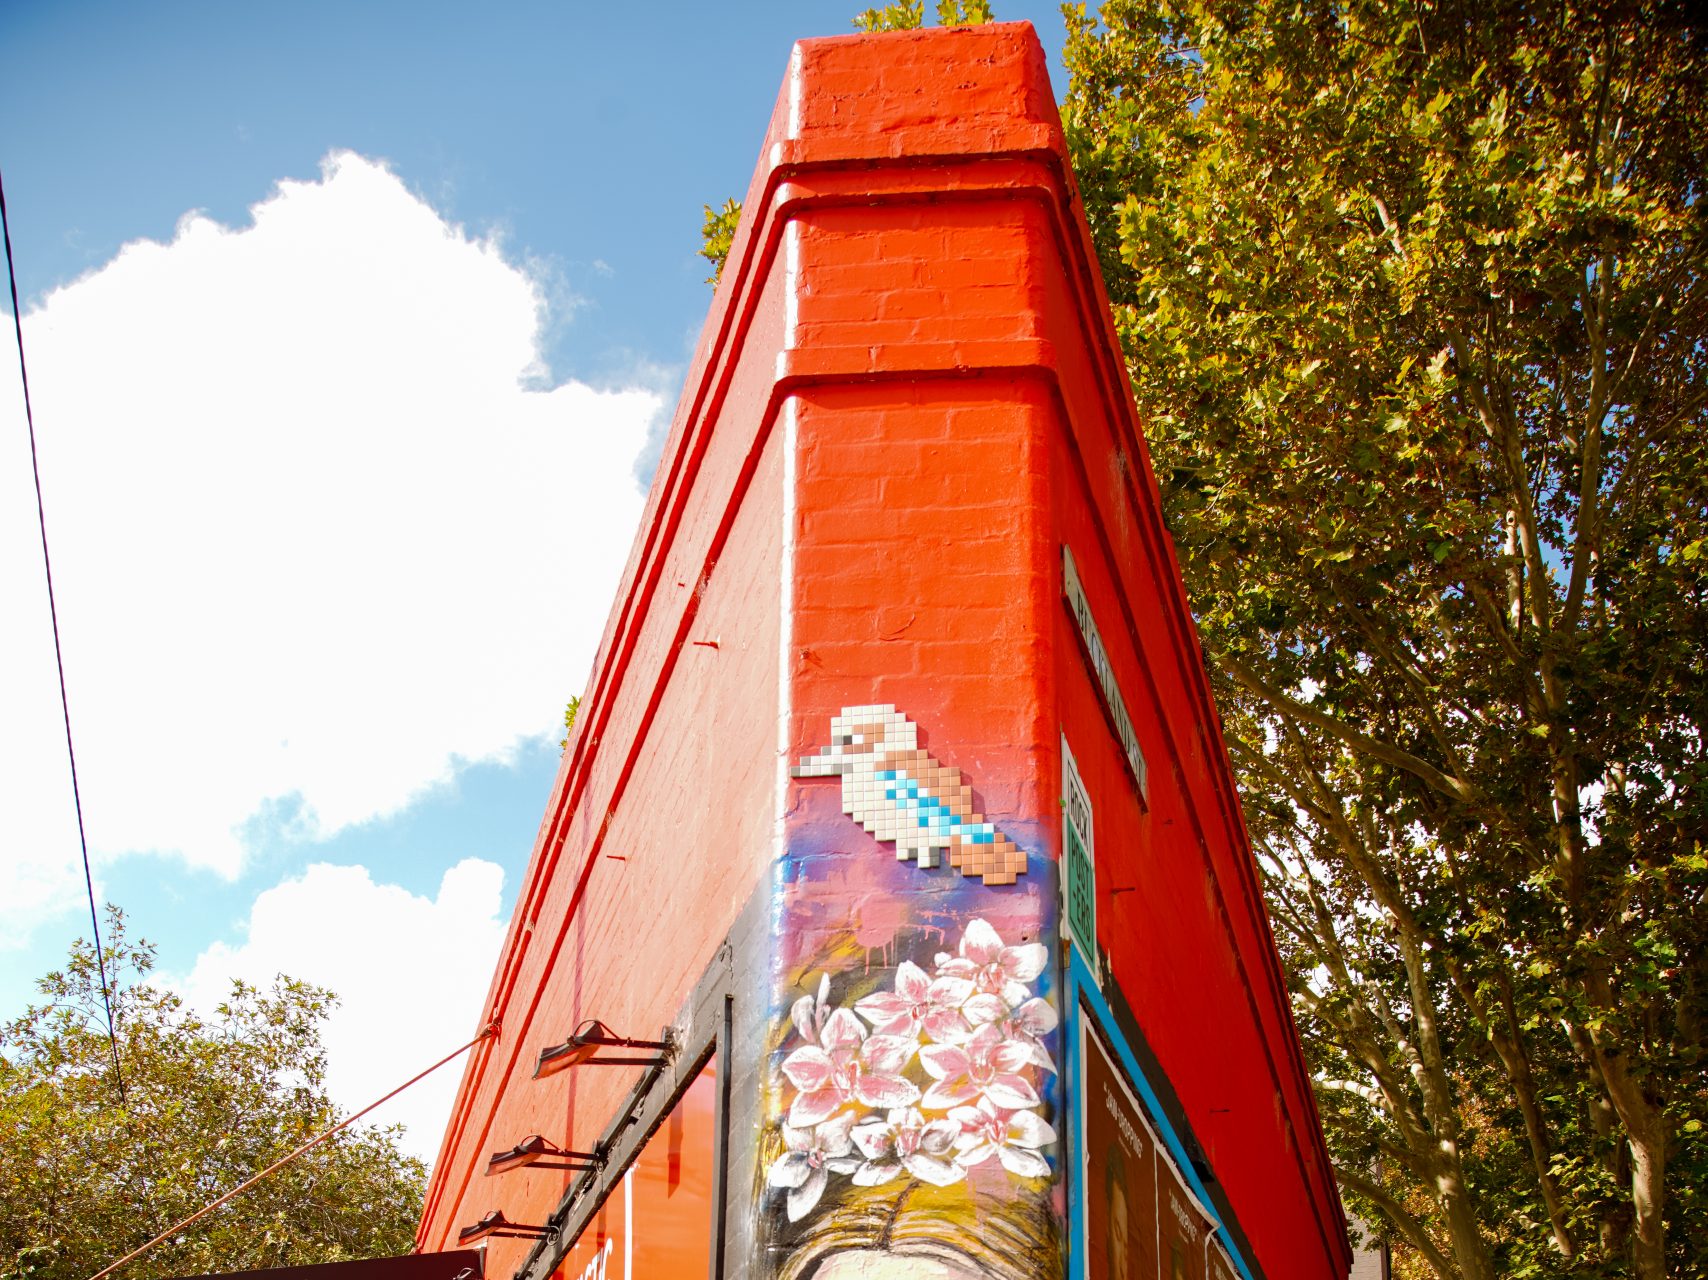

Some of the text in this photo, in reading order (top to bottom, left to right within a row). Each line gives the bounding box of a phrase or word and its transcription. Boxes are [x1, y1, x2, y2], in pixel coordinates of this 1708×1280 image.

[1078, 591, 1142, 785] BUCKLAND ST
[1070, 780, 1089, 852] ROCK
[1071, 832, 1089, 896] POST
